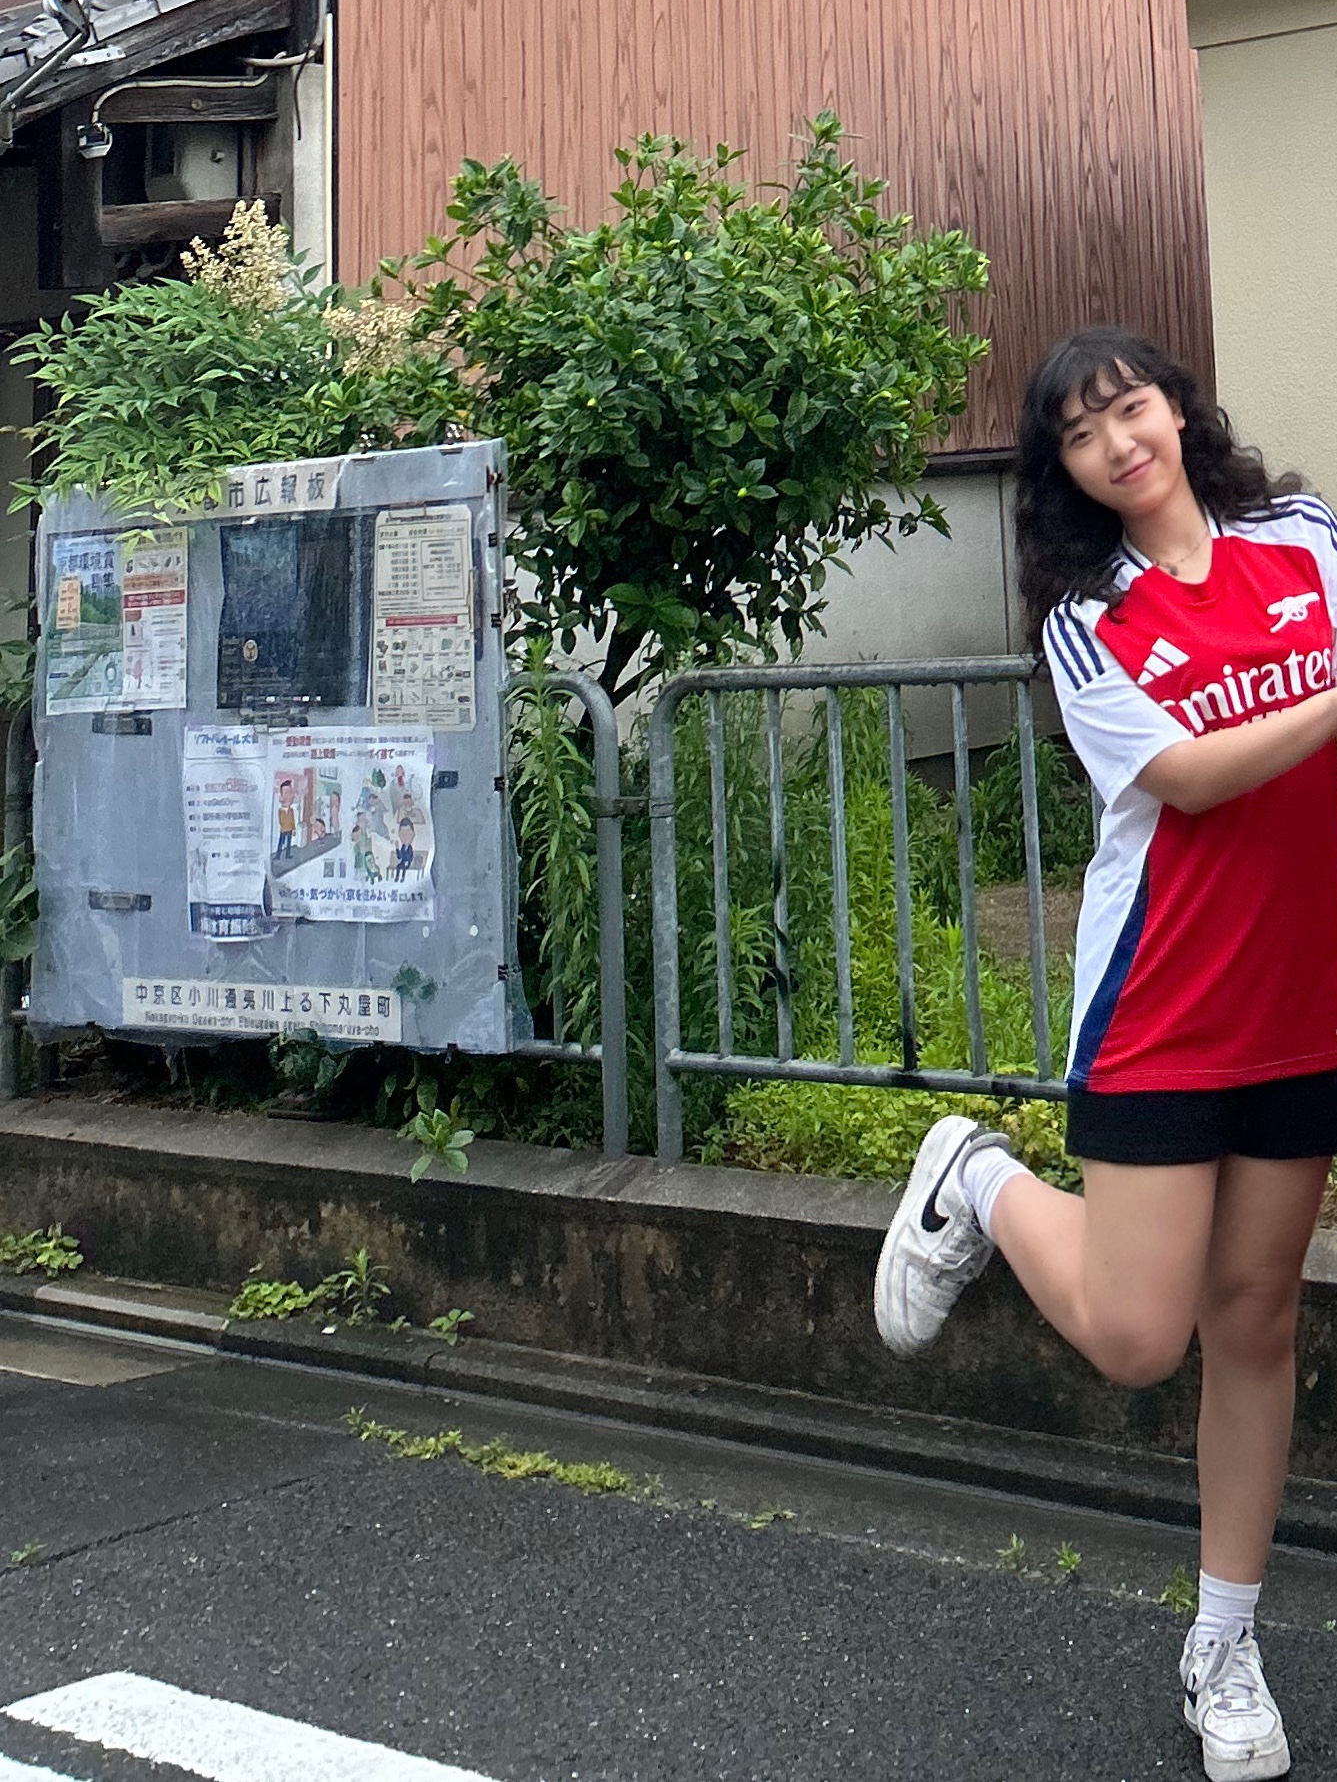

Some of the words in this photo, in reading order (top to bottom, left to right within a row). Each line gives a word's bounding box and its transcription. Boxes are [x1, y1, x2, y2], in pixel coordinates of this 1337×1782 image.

[1160, 646, 1332, 733] mirates
[135, 983, 391, 1018] 中京区小川通夷川上る下丸屋町
